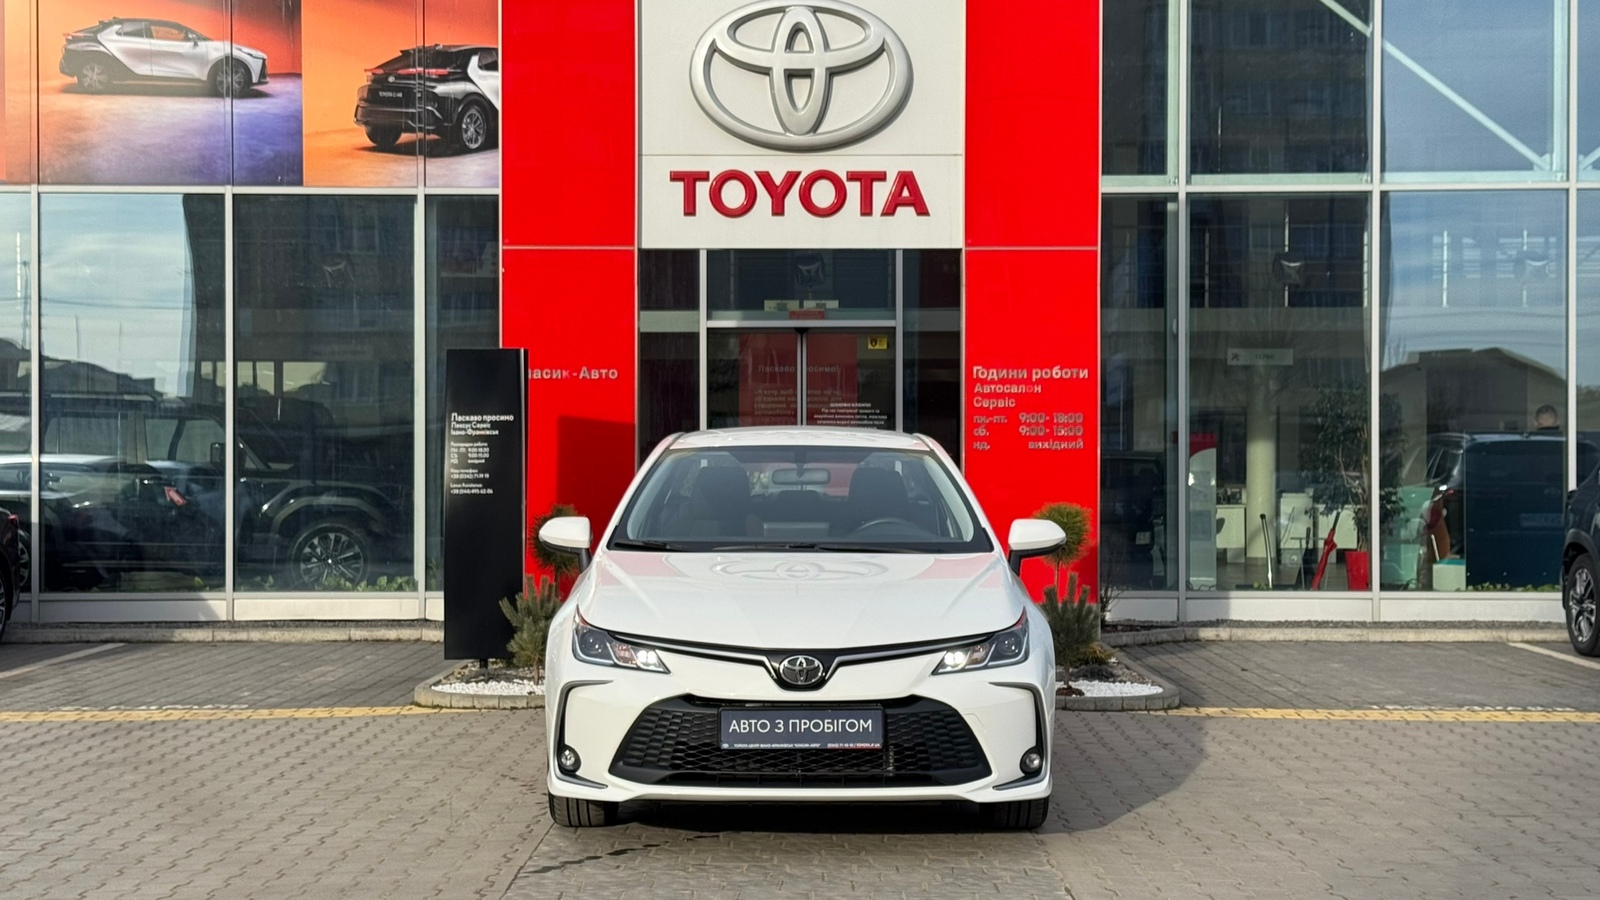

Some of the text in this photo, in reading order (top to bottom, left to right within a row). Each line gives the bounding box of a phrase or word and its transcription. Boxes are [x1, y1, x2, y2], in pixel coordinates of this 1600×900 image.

[669, 169, 930, 218] TOYOTA
[973, 365, 1088, 381] Години роботи
[974, 383, 1041, 393] Автосалон
[973, 397, 1016, 410] Сервіс
[483, 414, 514, 423] просимо
[1028, 439, 1084, 450] вихідний
[729, 719, 872, 733] АВТО З ПРОБІГОМ
